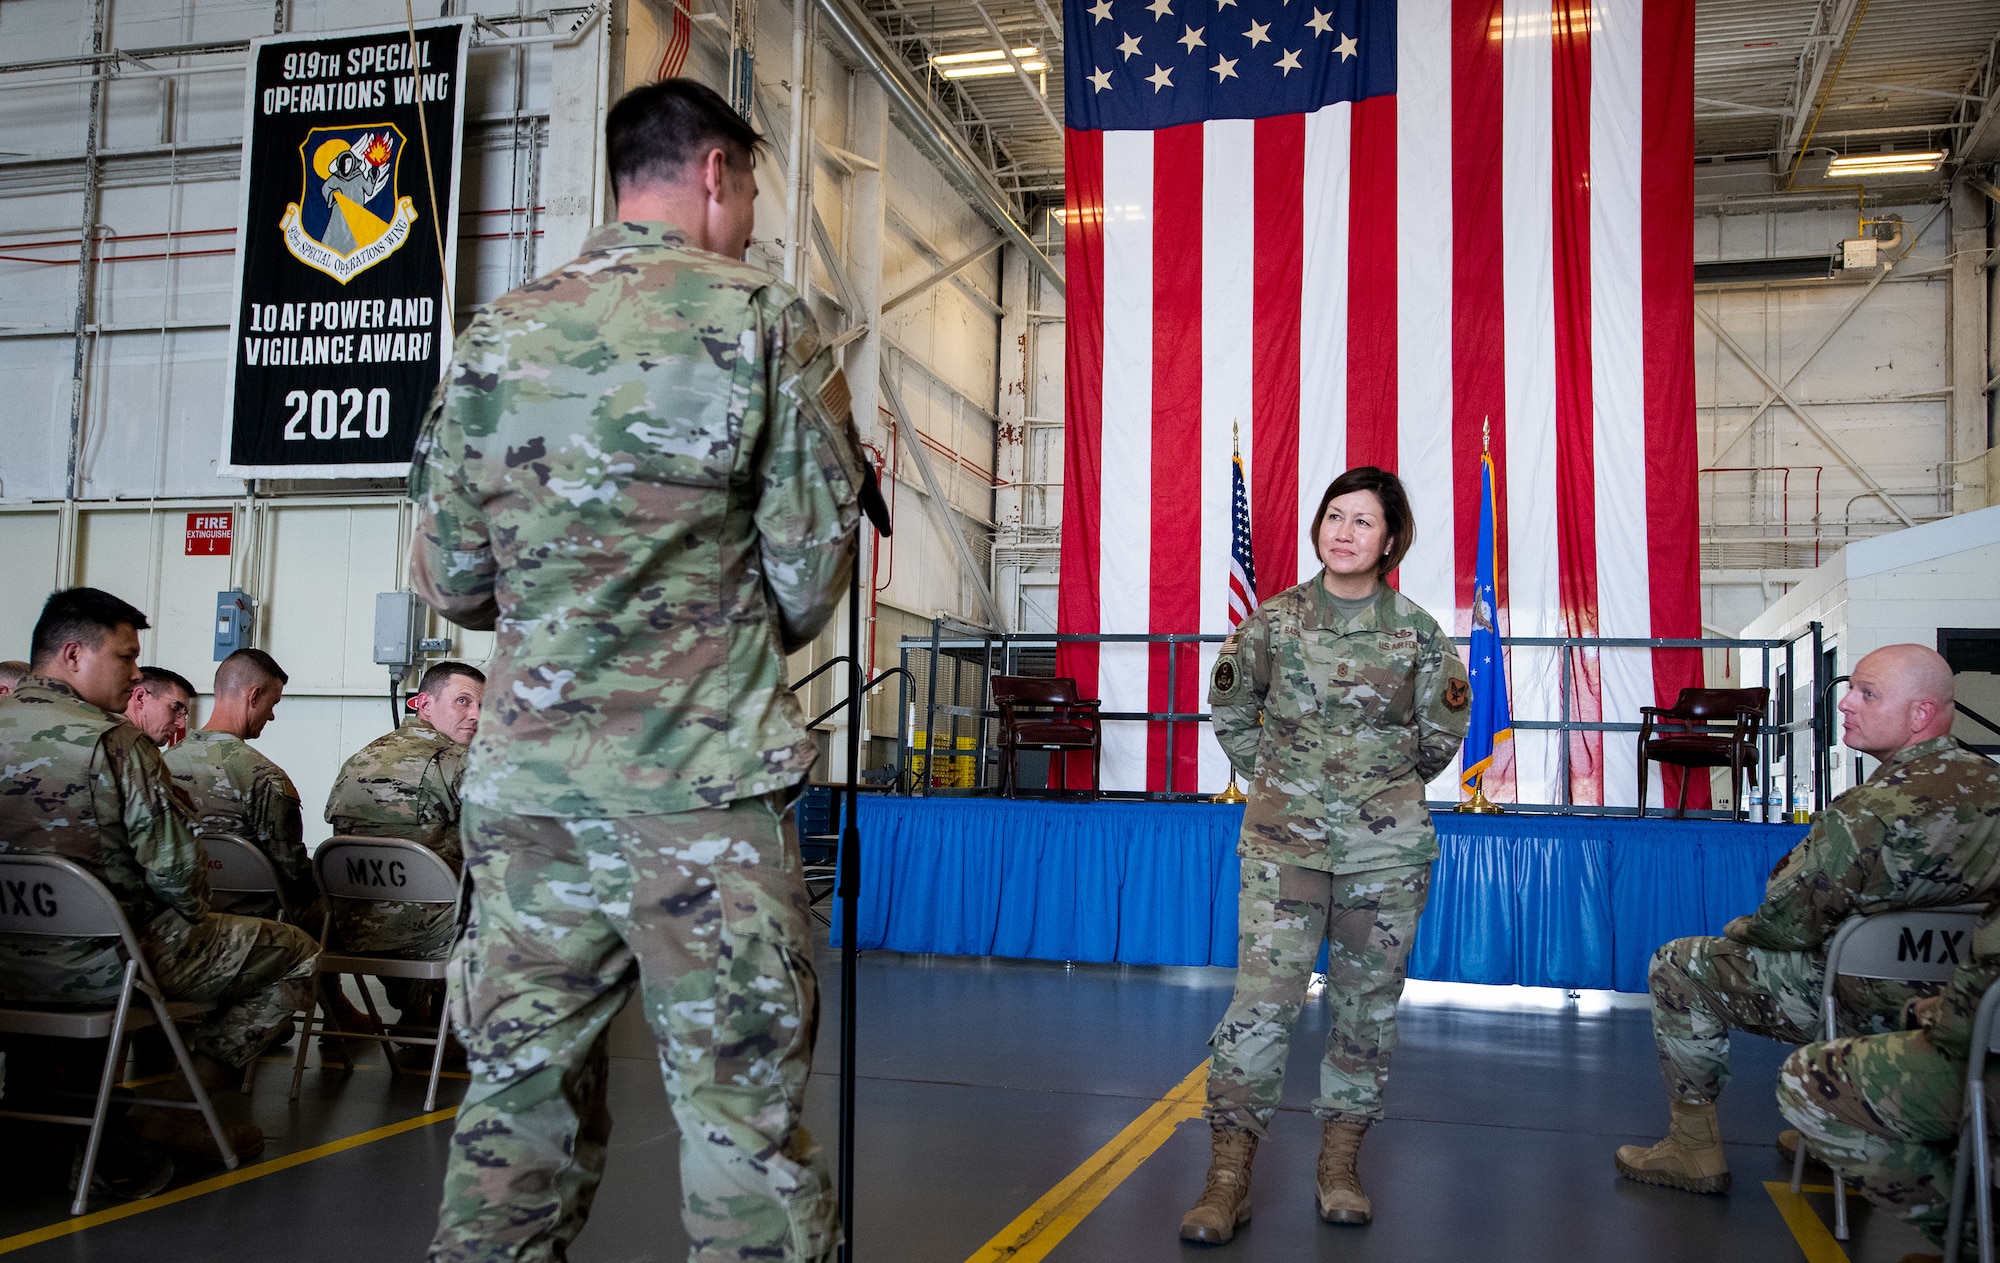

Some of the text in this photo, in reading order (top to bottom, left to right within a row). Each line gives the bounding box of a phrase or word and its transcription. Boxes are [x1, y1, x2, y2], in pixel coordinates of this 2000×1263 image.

[283, 40, 431, 80] 919TH SPECIAL
[263, 72, 450, 116] OPERATIONS WING
[300, 241, 331, 268] SPECIAL
[334, 241, 387, 277] OPERATIONS
[384, 219, 408, 246] WING
[250, 297, 434, 332] 10 AF POWER AND
[245, 332, 432, 366] VIGILANCE AWARD
[284, 387, 391, 441] 2020
[186, 530, 232, 538] EXTINGUISHE
[195, 517, 228, 529] FIRE
[1391, 641, 1405, 650] AIR
[1405, 640, 1418, 650] FOR
[207, 860, 223, 870] XG
[346, 857, 408, 888] MXG
[0, 880, 57, 918] XG
[1897, 926, 1977, 965] MX
